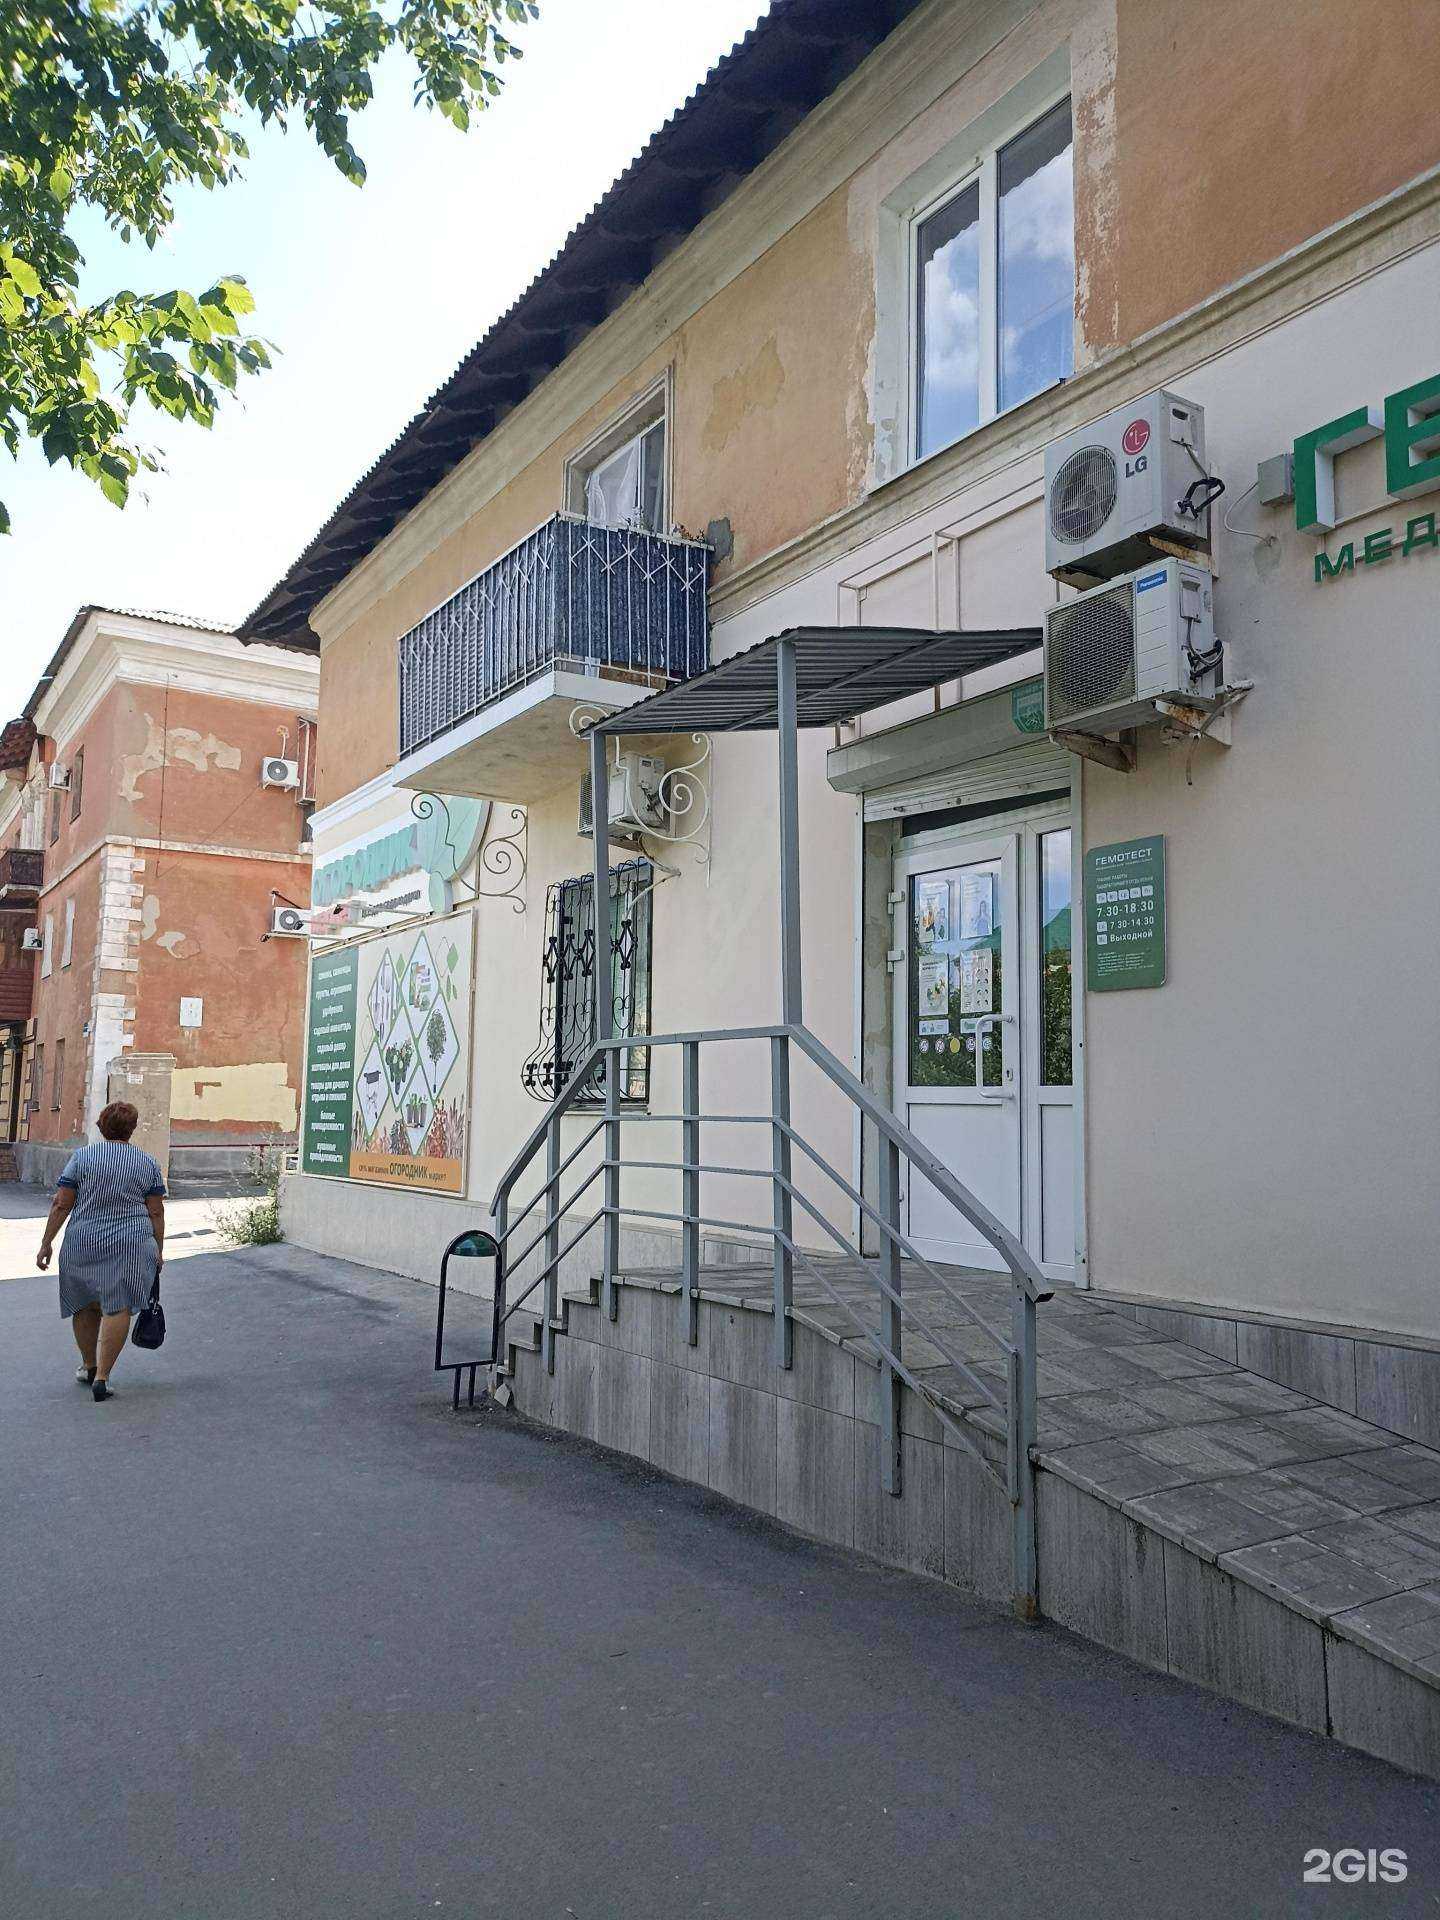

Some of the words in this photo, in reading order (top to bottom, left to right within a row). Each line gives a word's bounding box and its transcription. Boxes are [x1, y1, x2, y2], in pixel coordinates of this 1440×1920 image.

[1125, 456, 1148, 478] LG
[1314, 512, 1439, 583] МЕД
[1095, 848, 1152, 866] ГЕМОТЕСТ
[1110, 929, 1153, 943] Выходной
[389, 1162, 429, 1181] ОГОРОДНИК
